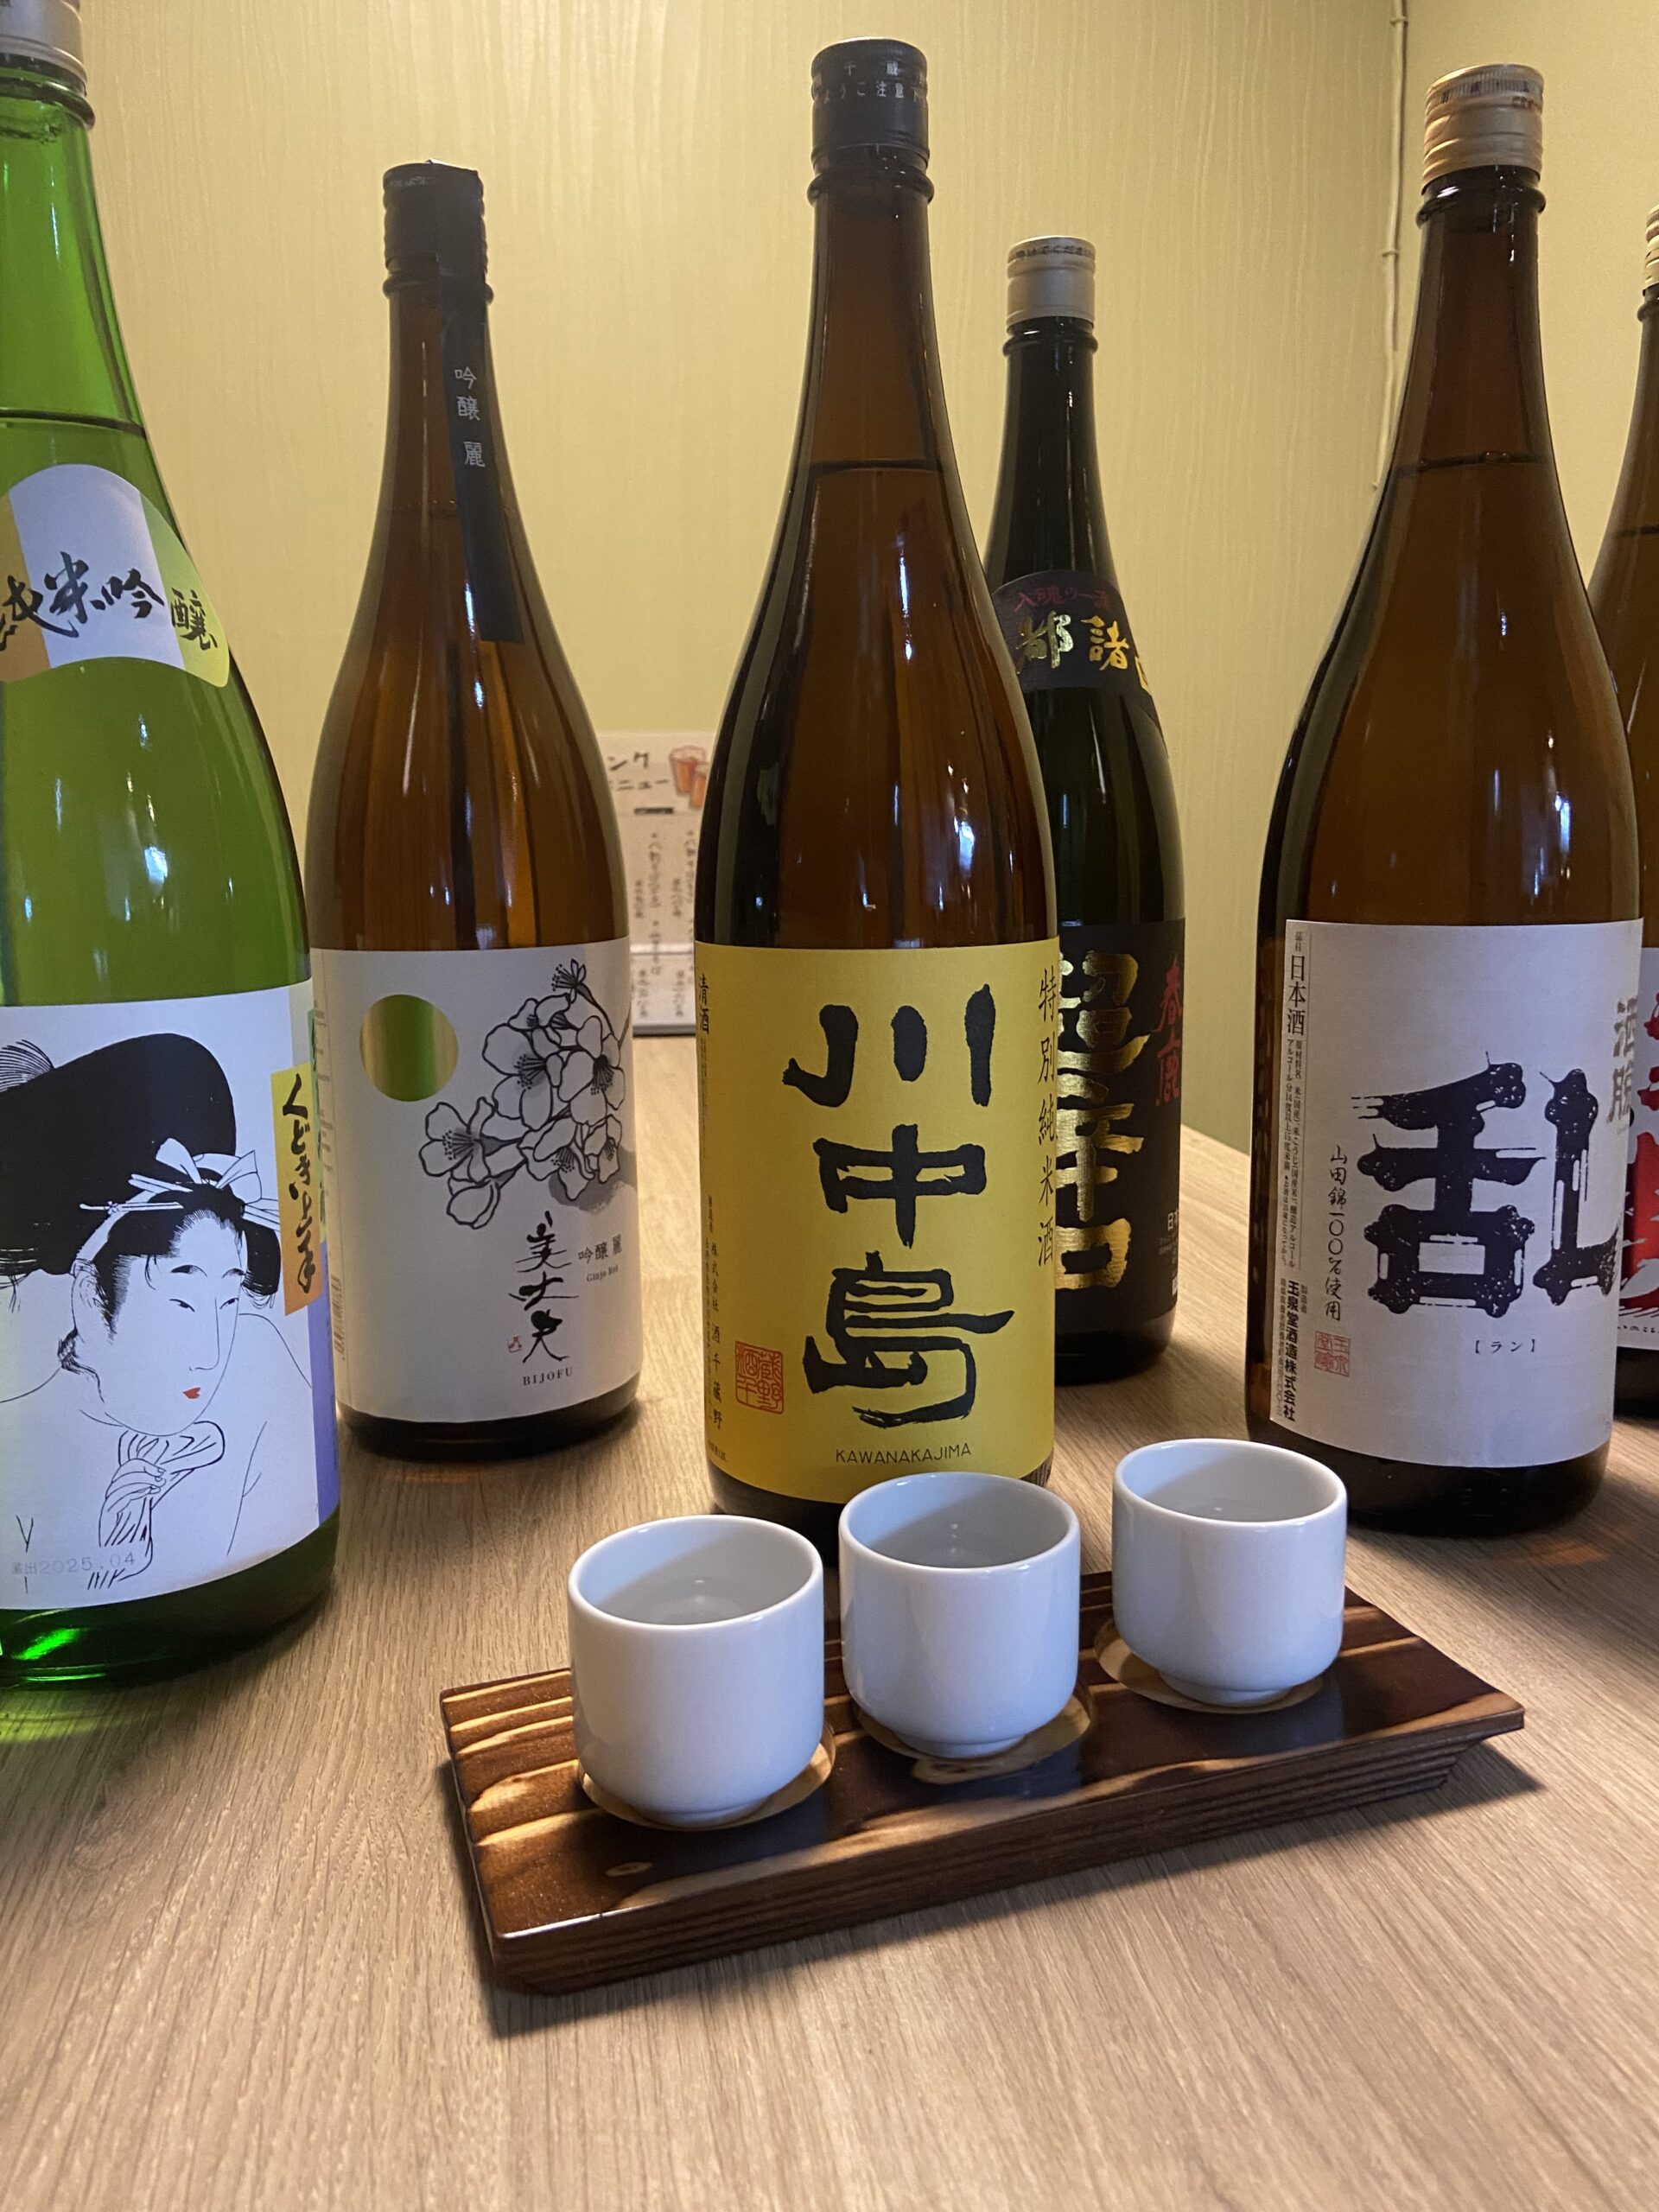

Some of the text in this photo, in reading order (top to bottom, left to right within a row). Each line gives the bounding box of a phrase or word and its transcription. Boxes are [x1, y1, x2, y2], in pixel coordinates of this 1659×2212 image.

[454, 366, 485, 467] 吟醸 麗
[1016, 610, 1149, 690] 都諸
[699, 973, 709, 1034] 清酒
[1287, 955, 1306, 1036] 日本酒
[1037, 967, 1058, 1267] 特別純米酒
[283, 1073, 316, 1294] くどき上手
[782, 984, 1014, 1427] 川中島
[509, 1211, 580, 1363] 美丈夫
[578, 1242, 608, 1263] 吟醸
[523, 1367, 573, 1386] BIJOFU
[1283, 1280, 1300, 1421] 玉泉堂酒造株式会社
[836, 1443, 971, 1464] KAWANAKAJIMA
